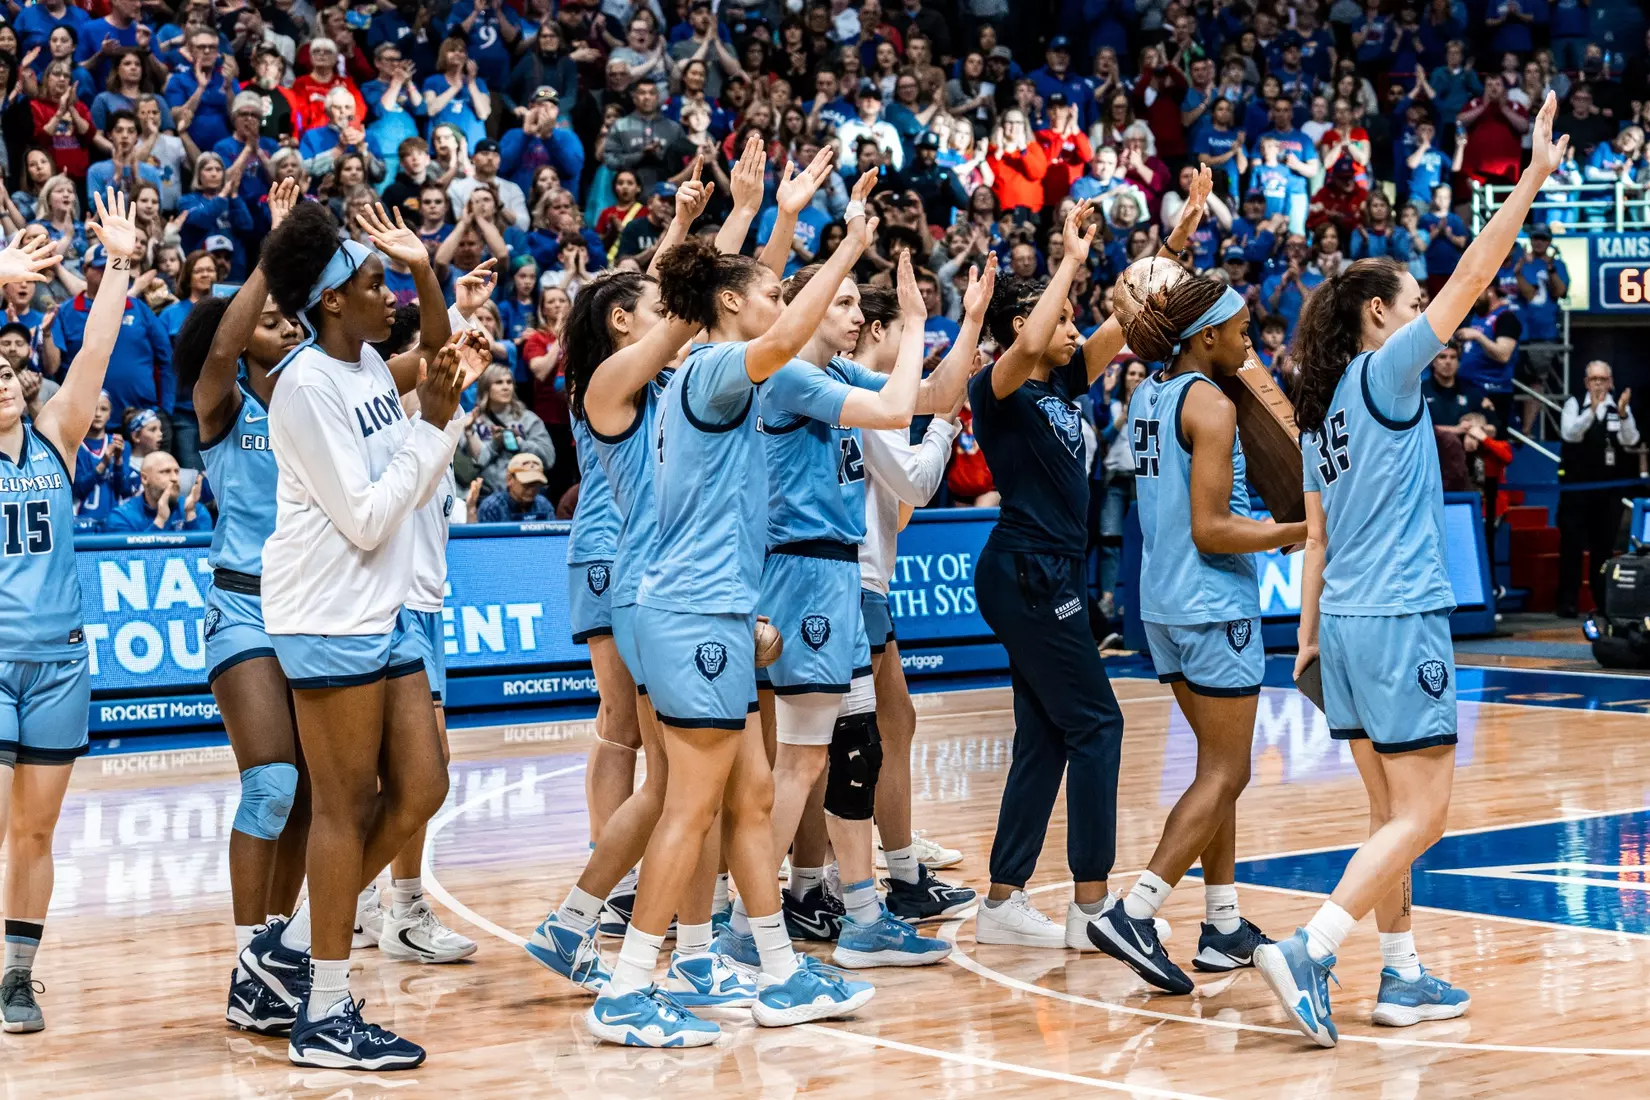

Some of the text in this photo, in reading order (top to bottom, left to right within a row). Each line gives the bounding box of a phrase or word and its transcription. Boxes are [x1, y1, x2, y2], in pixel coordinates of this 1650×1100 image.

[479, 25, 498, 50] 9
[1597, 236, 1650, 258] KANS
[111, 257, 131, 271] 22
[836, 435, 866, 487] 12
[1133, 417, 1161, 479] 23
[1310, 407, 1352, 488] 35
[1, 499, 54, 558] 15
[936, 552, 972, 582] OF
[888, 588, 930, 618] TH
[83, 618, 207, 676] TOU
[899, 654, 944, 670] ortgage
[503, 677, 560, 696] ROCKET
[100, 703, 168, 723] ROCKET
